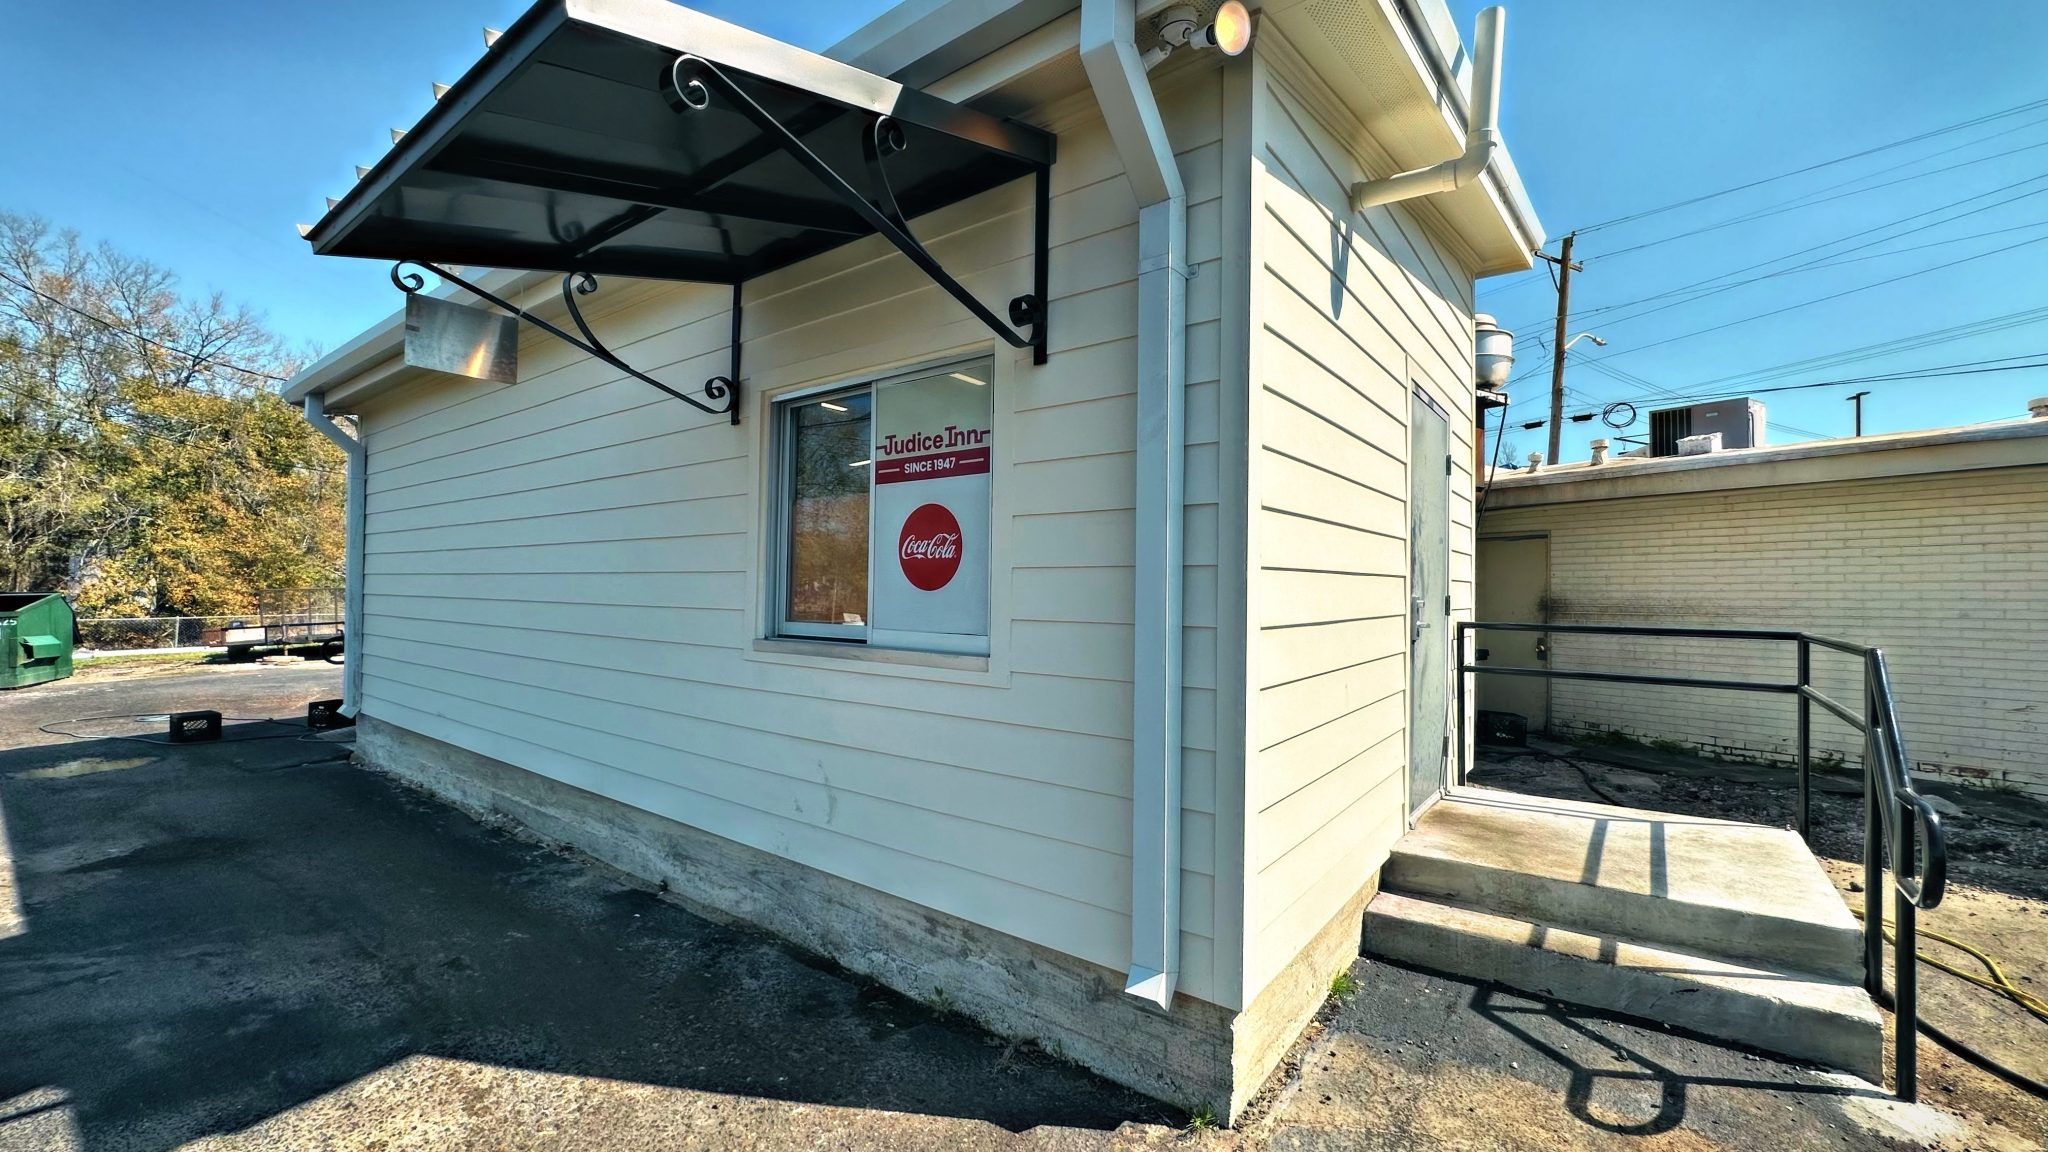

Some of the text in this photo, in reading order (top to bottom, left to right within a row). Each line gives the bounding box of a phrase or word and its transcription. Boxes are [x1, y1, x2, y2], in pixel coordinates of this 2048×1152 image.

[876, 425, 990, 455] Judice Inn
[904, 457, 956, 474] SINCE 1947
